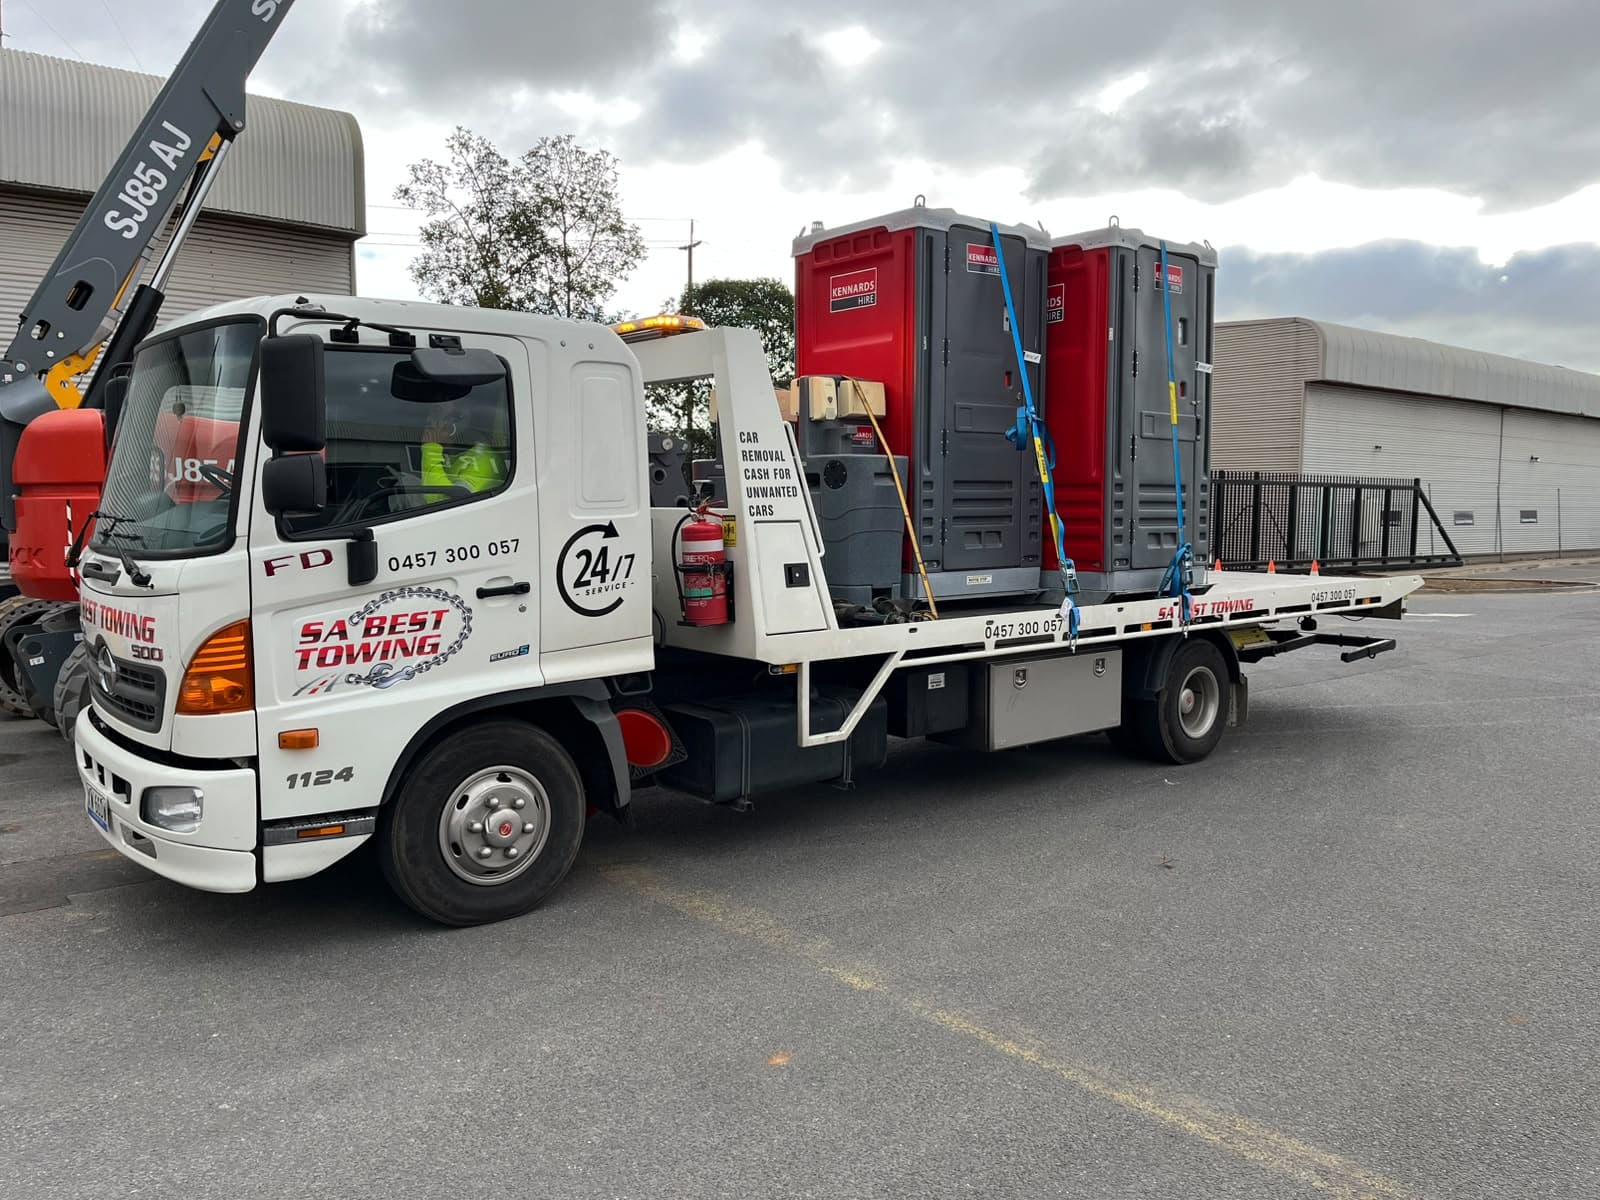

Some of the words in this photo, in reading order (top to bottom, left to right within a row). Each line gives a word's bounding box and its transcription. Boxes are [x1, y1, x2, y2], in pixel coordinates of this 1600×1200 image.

[104, 161, 169, 240] SJ85
[148, 119, 193, 171] AJ
[968, 253, 999, 264] KENNARD
[832, 279, 875, 298] KENNARDS
[858, 293, 875, 306] HIRE
[739, 431, 759, 444] CAR
[742, 450, 786, 462] REMOVAL
[744, 468, 770, 480] CASH
[773, 468, 791, 480] FOR
[746, 485, 798, 499] UNWANTED
[748, 504, 774, 517] CARS
[388, 551, 437, 572] 0457
[446, 543, 480, 564] 300
[488, 538, 521, 558] 057
[573, 544, 635, 589] 24/7
[1311, 591, 1328, 602] 0457
[1330, 590, 1342, 601] 300
[1344, 588, 1356, 599] 057
[1158, 607, 1174, 621] SA
[1191, 603, 1207, 616] ST
[1211, 598, 1254, 614] TOWING
[100, 604, 156, 644] TOWING
[299, 619, 350, 646] SA
[361, 608, 450, 639] BEST
[985, 623, 1014, 639] 0457
[1018, 621, 1039, 635] 300
[1043, 619, 1063, 632] 057
[131, 643, 164, 662] 500
[294, 633, 443, 671] TOWING
[286, 766, 354, 790] 1124
